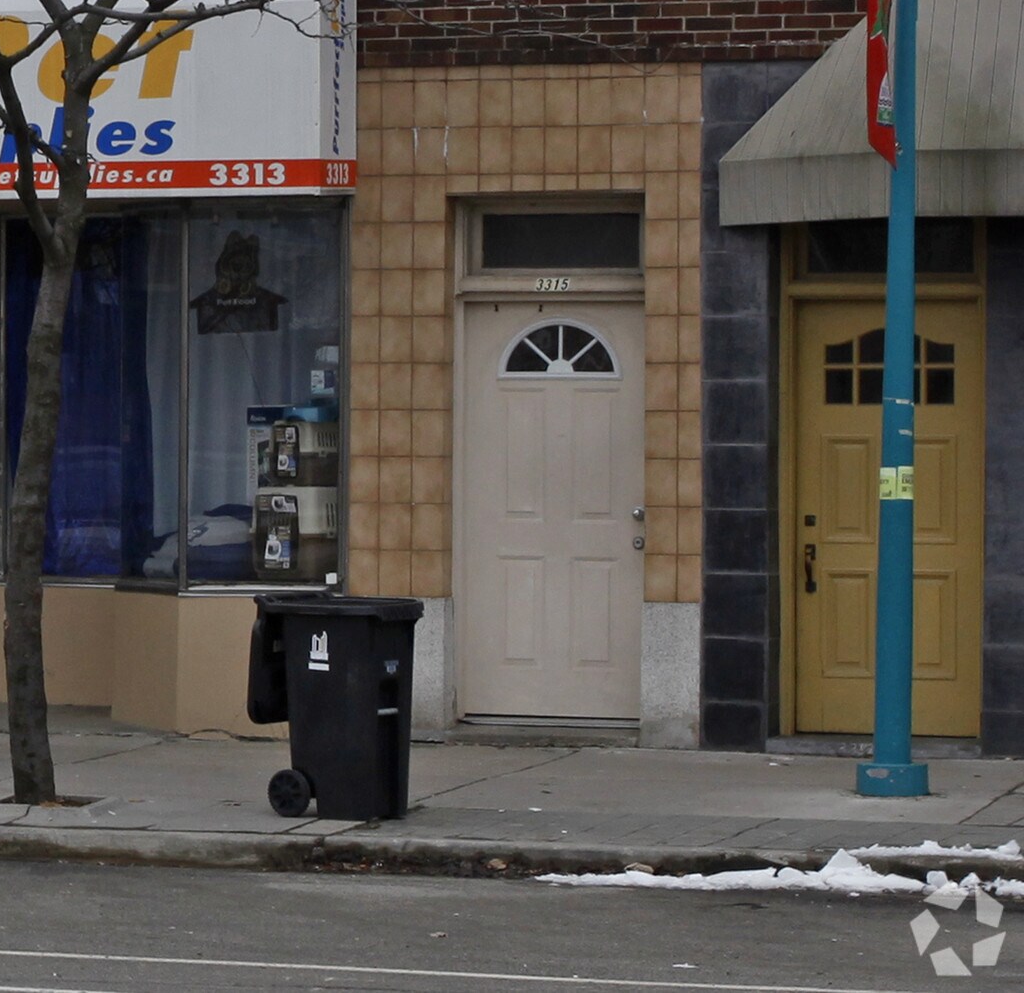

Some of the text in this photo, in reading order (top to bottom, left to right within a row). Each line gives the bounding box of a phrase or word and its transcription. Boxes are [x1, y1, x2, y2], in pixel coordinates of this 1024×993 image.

[209, 163, 286, 186] 3313
[326, 163, 349, 185] 3313
[536, 278, 569, 291] 3315
